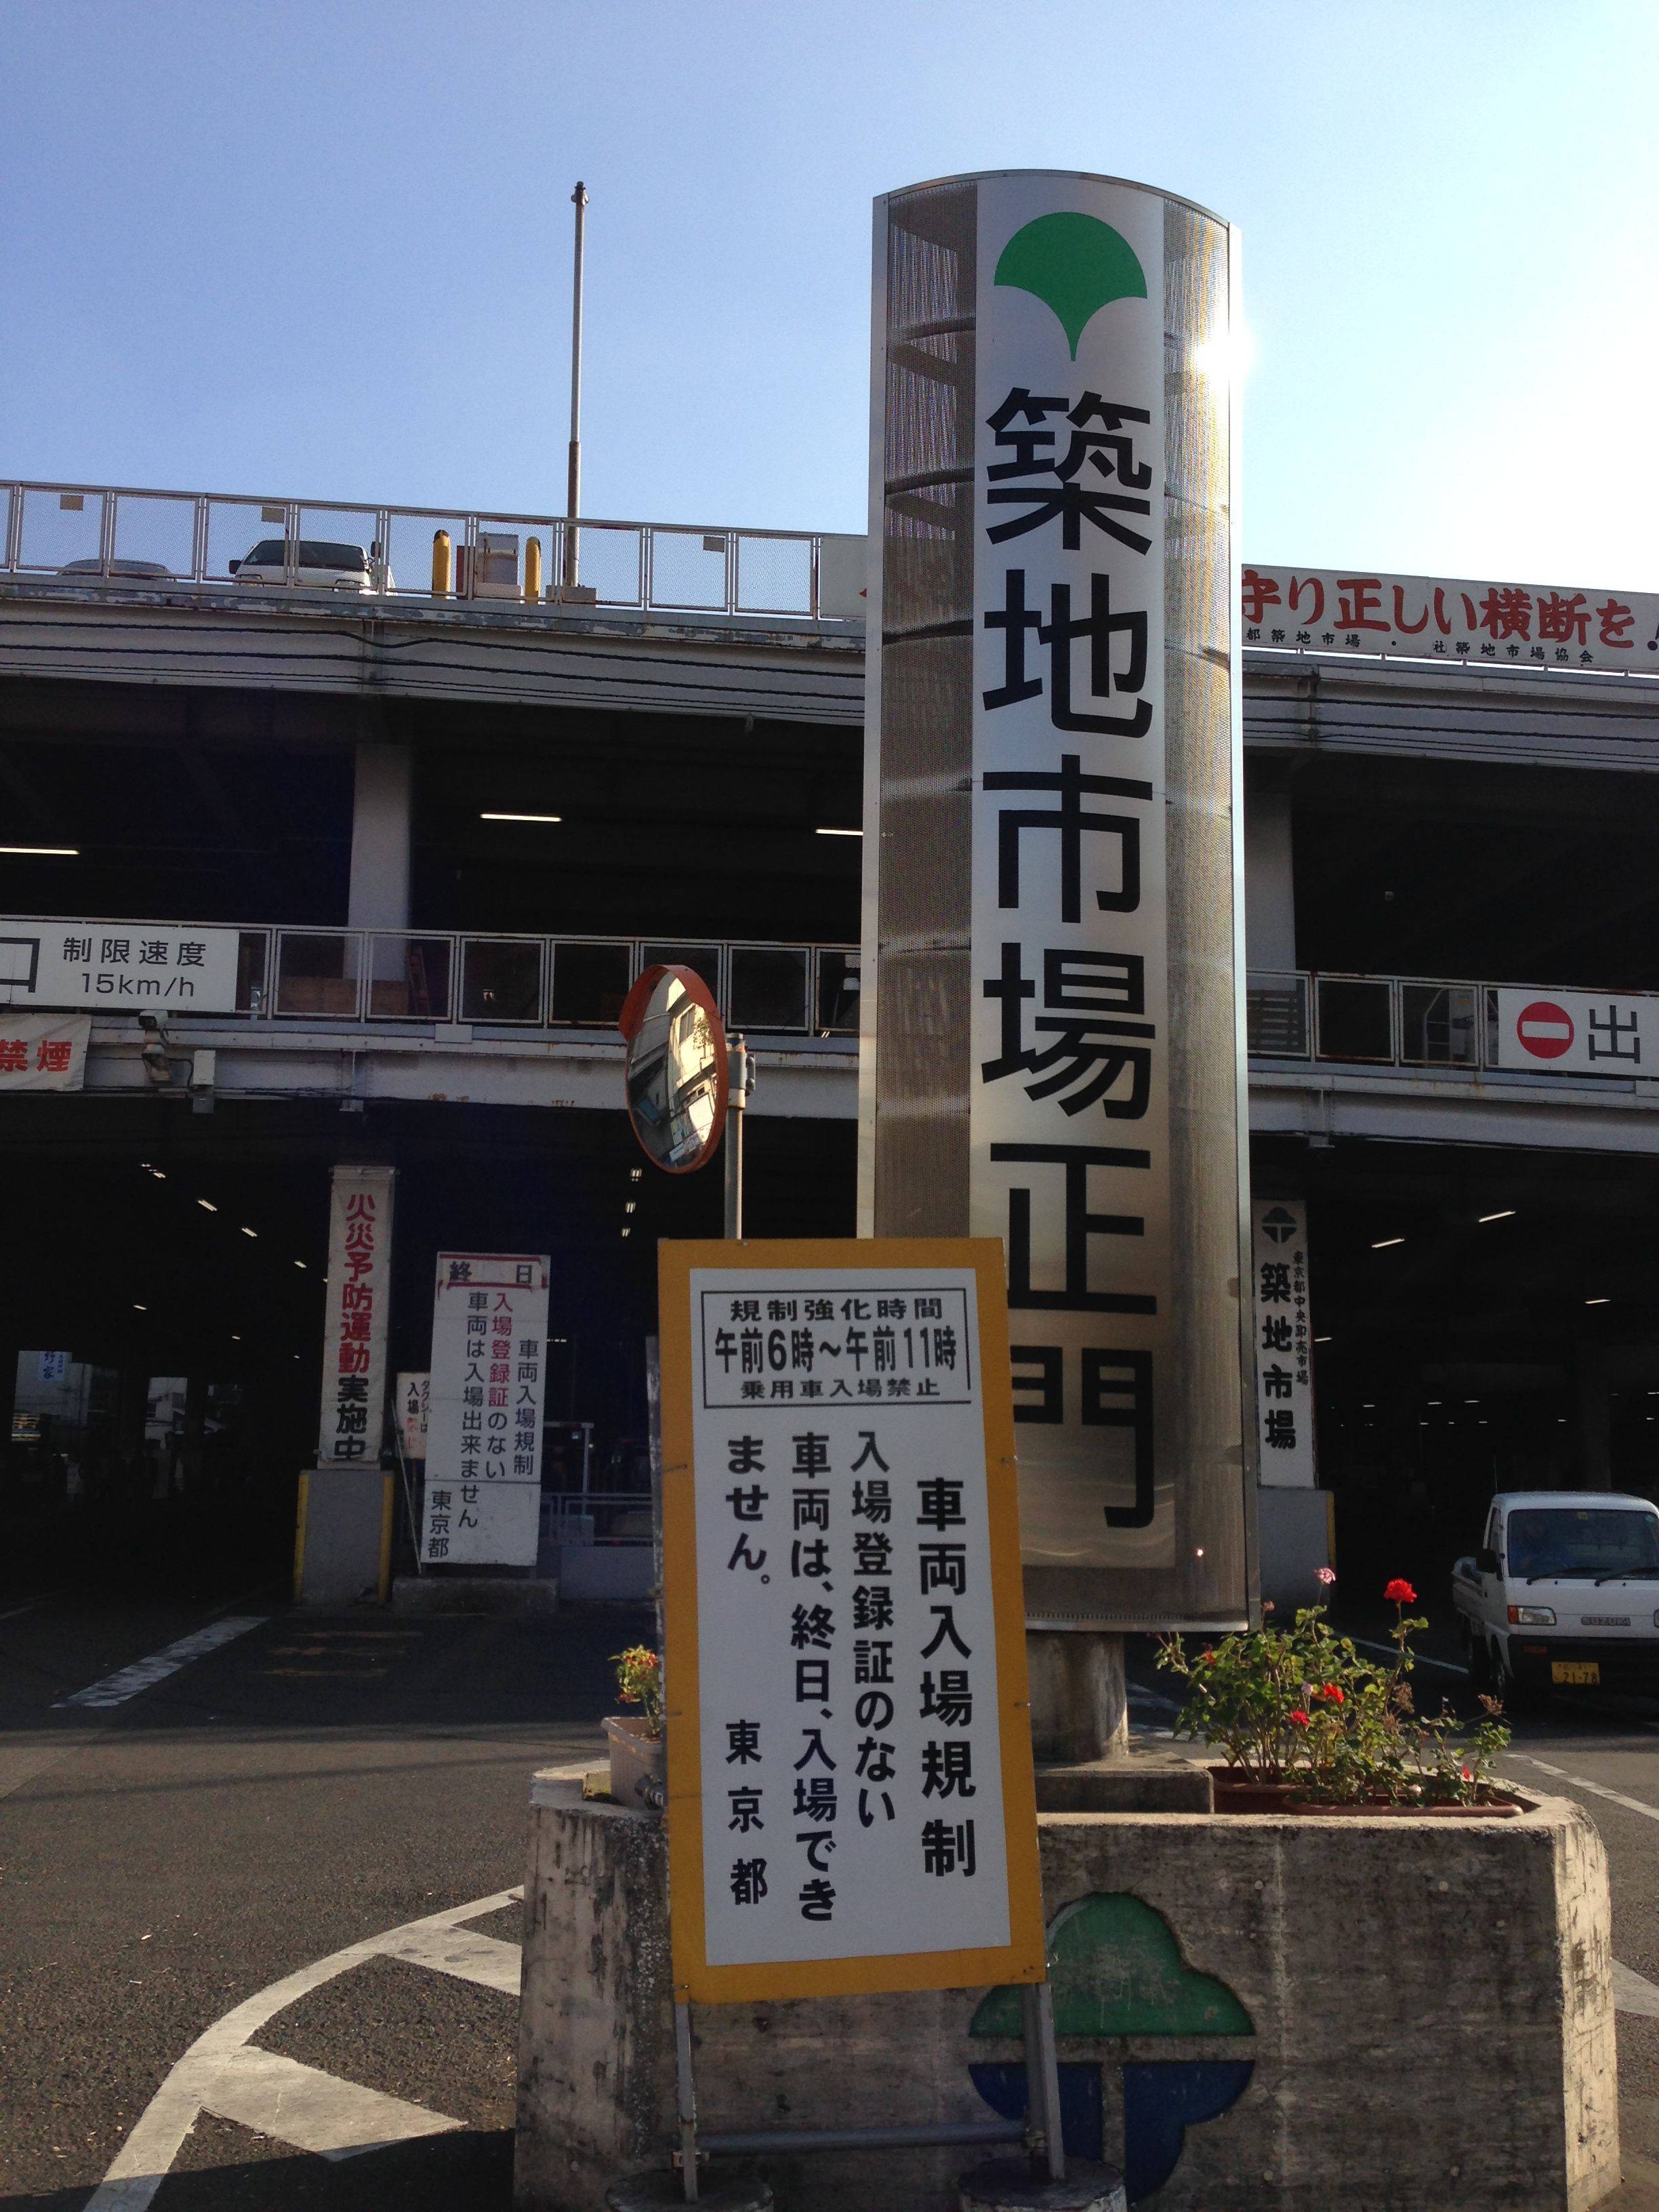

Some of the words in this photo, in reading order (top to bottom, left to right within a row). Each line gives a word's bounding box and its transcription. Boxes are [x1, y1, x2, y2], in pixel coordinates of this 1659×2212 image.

[64, 937, 206, 967] 制限速度
[82, 973, 194, 997] 15km/h
[982, 387, 1156, 1529] 築地市場正門
[0, 1040, 72, 1072] 禁煙
[1588, 1004, 1641, 1064] 出
[332, 1193, 376, 1461] 火災予防運動実施中
[449, 1261, 533, 1284] 終日
[731, 1298, 943, 1322] 規制強化時間
[457, 1291, 489, 1528] 車両は入場出来ません
[485, 1292, 513, 1479] 入場登録証のない
[513, 1339, 539, 1475] 車両入場規制
[740, 1378, 941, 1400] 乗用車入場禁止
[1260, 1262, 1296, 1450] 築地市場
[428, 1490, 452, 1559] 東京都
[725, 1435, 771, 1584] ません。
[790, 1432, 838, 1921] 車両は、終日、入場でき
[851, 1431, 897, 1828] 入場登録証のない
[916, 1477, 977, 1877] 車両入場規制
[725, 1719, 768, 1906] 東京都
